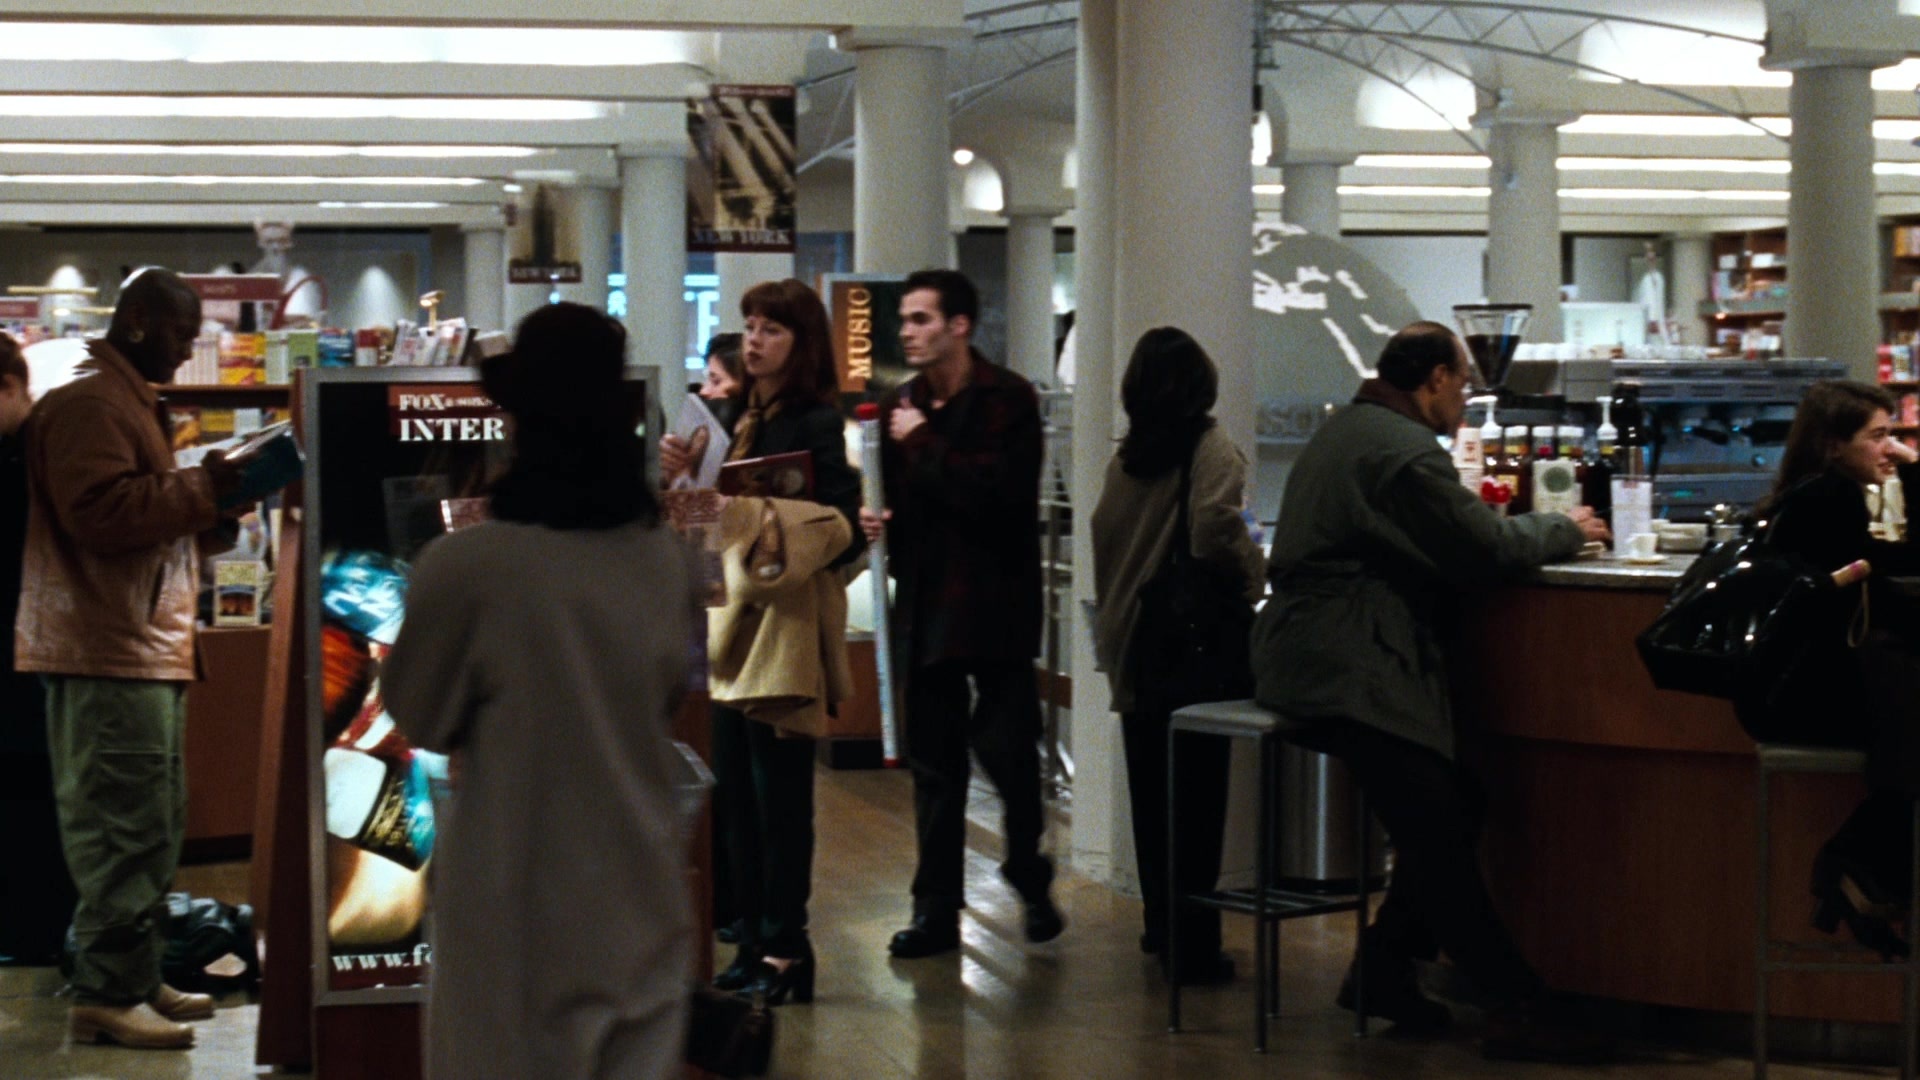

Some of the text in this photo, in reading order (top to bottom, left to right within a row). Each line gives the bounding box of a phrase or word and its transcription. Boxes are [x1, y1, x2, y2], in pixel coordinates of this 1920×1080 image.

[740, 229, 790, 245] YORK
[847, 287, 872, 379] MUSIC
[399, 393, 445, 411] FOX
[400, 417, 504, 442] INTER
